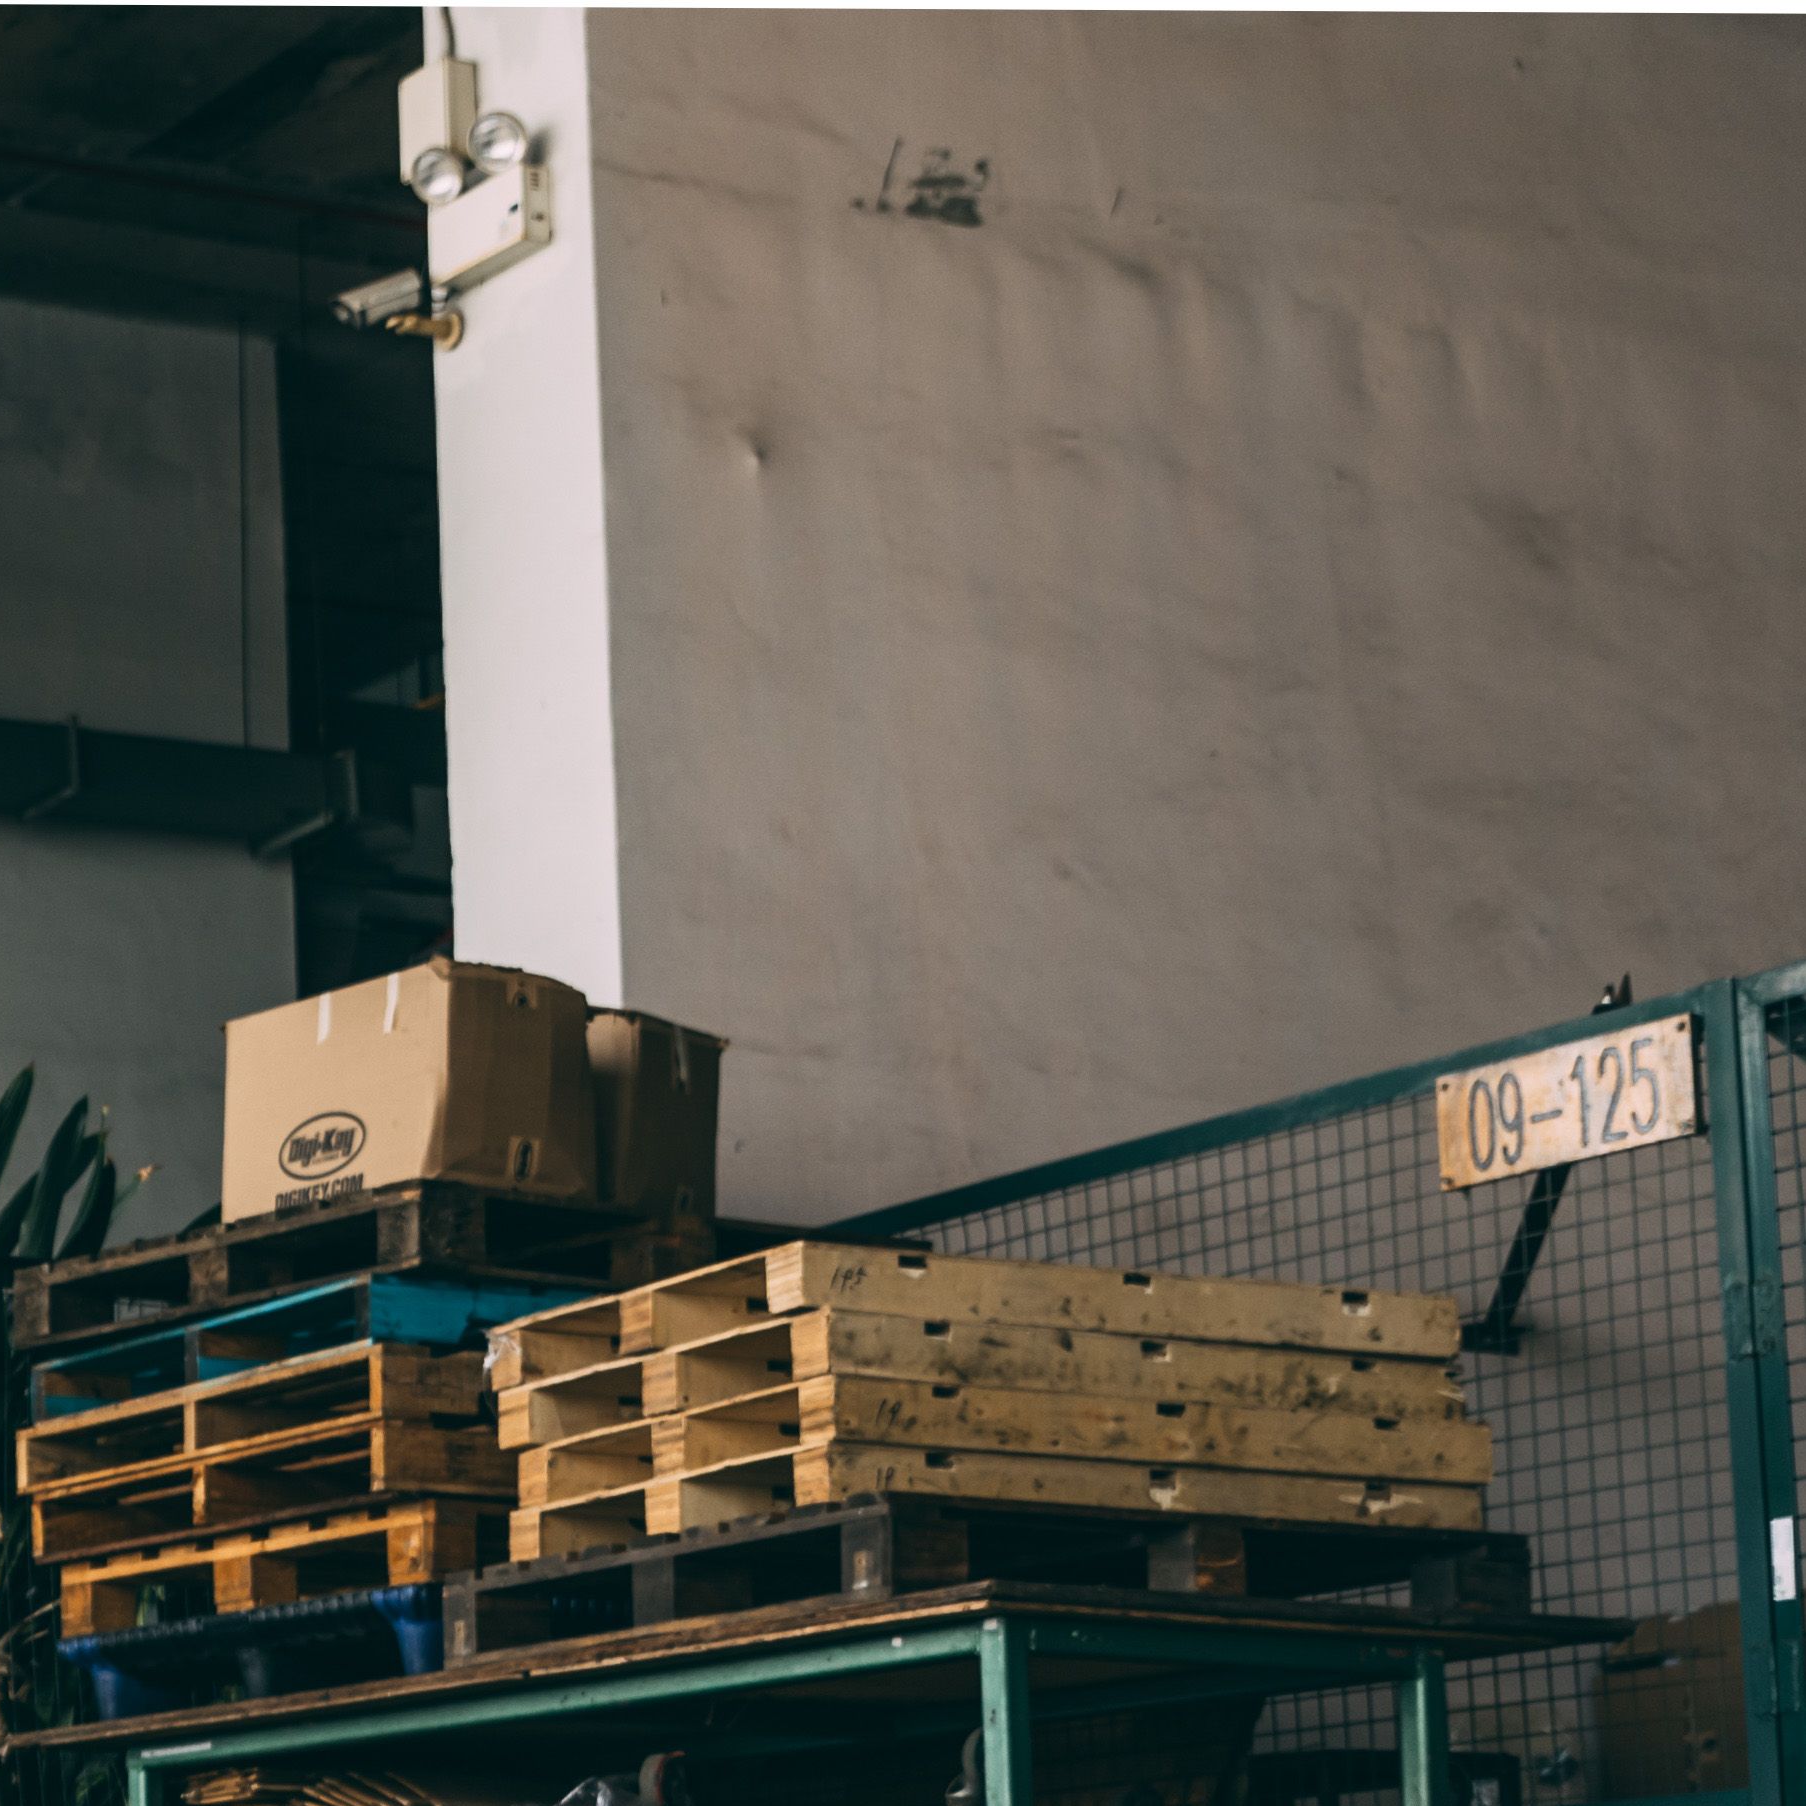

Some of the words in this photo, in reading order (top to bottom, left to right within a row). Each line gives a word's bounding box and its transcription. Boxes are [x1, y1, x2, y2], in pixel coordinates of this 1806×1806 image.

[1468, 1037, 1660, 1172] 09-125
[287, 1127, 356, 1167] Digi-Key
[274, 1173, 365, 1208] DIGIKEY.COM
